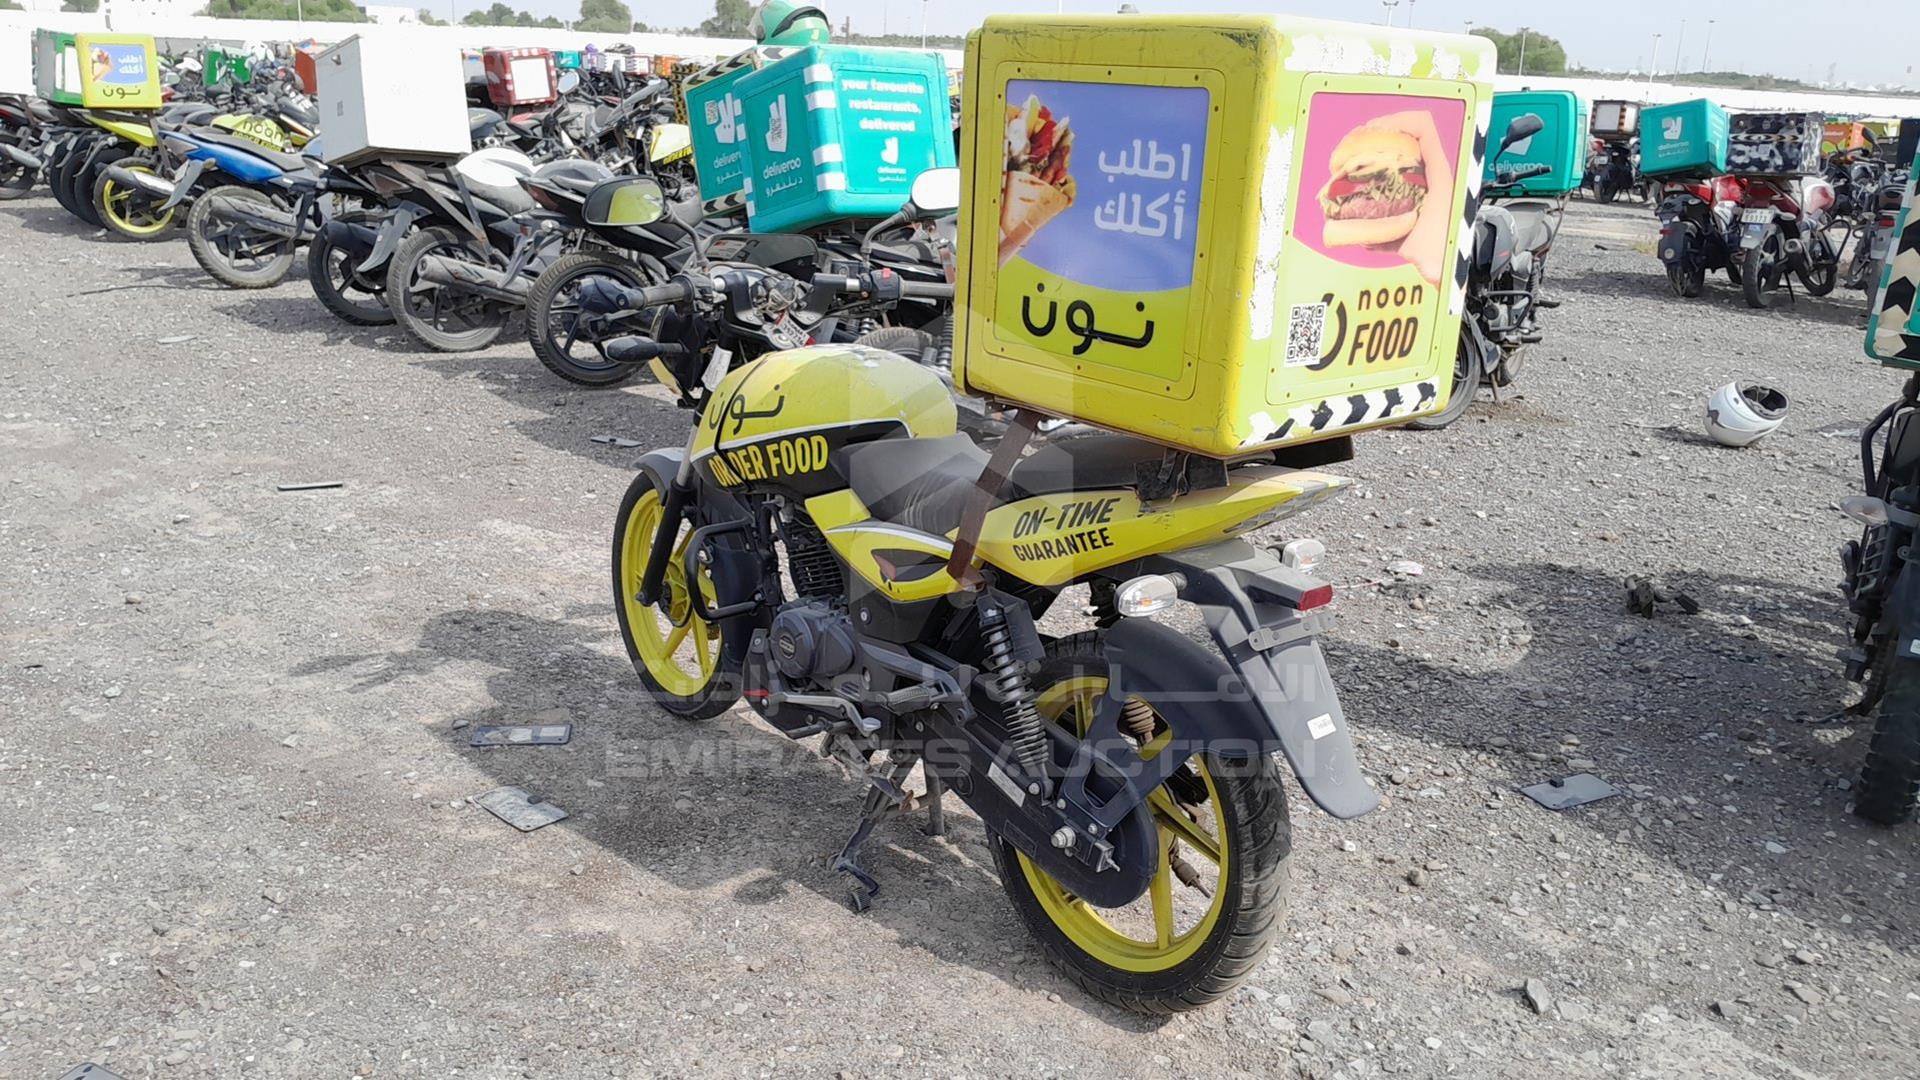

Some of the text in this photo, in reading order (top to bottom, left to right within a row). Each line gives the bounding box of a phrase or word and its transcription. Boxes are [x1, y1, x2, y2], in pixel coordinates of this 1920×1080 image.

[103, 85, 141, 99] نون
[841, 78, 924, 95] your favourite
[243, 119, 285, 141] noon
[860, 117, 916, 132] delivered
[713, 152, 741, 169] deliver
[763, 157, 801, 180] deliveroo
[1098, 138, 1191, 183] اطلب
[1094, 189, 1187, 240] أكلك
[1358, 284, 1423, 311] noon
[1022, 282, 1155, 355] نون
[1347, 316, 1419, 366] FOOD
[709, 384, 785, 436] نون
[708, 434, 829, 488] ORDER FOOD
[1012, 498, 1121, 539] ON-TIME
[1012, 527, 1115, 562] GUARANTEE
